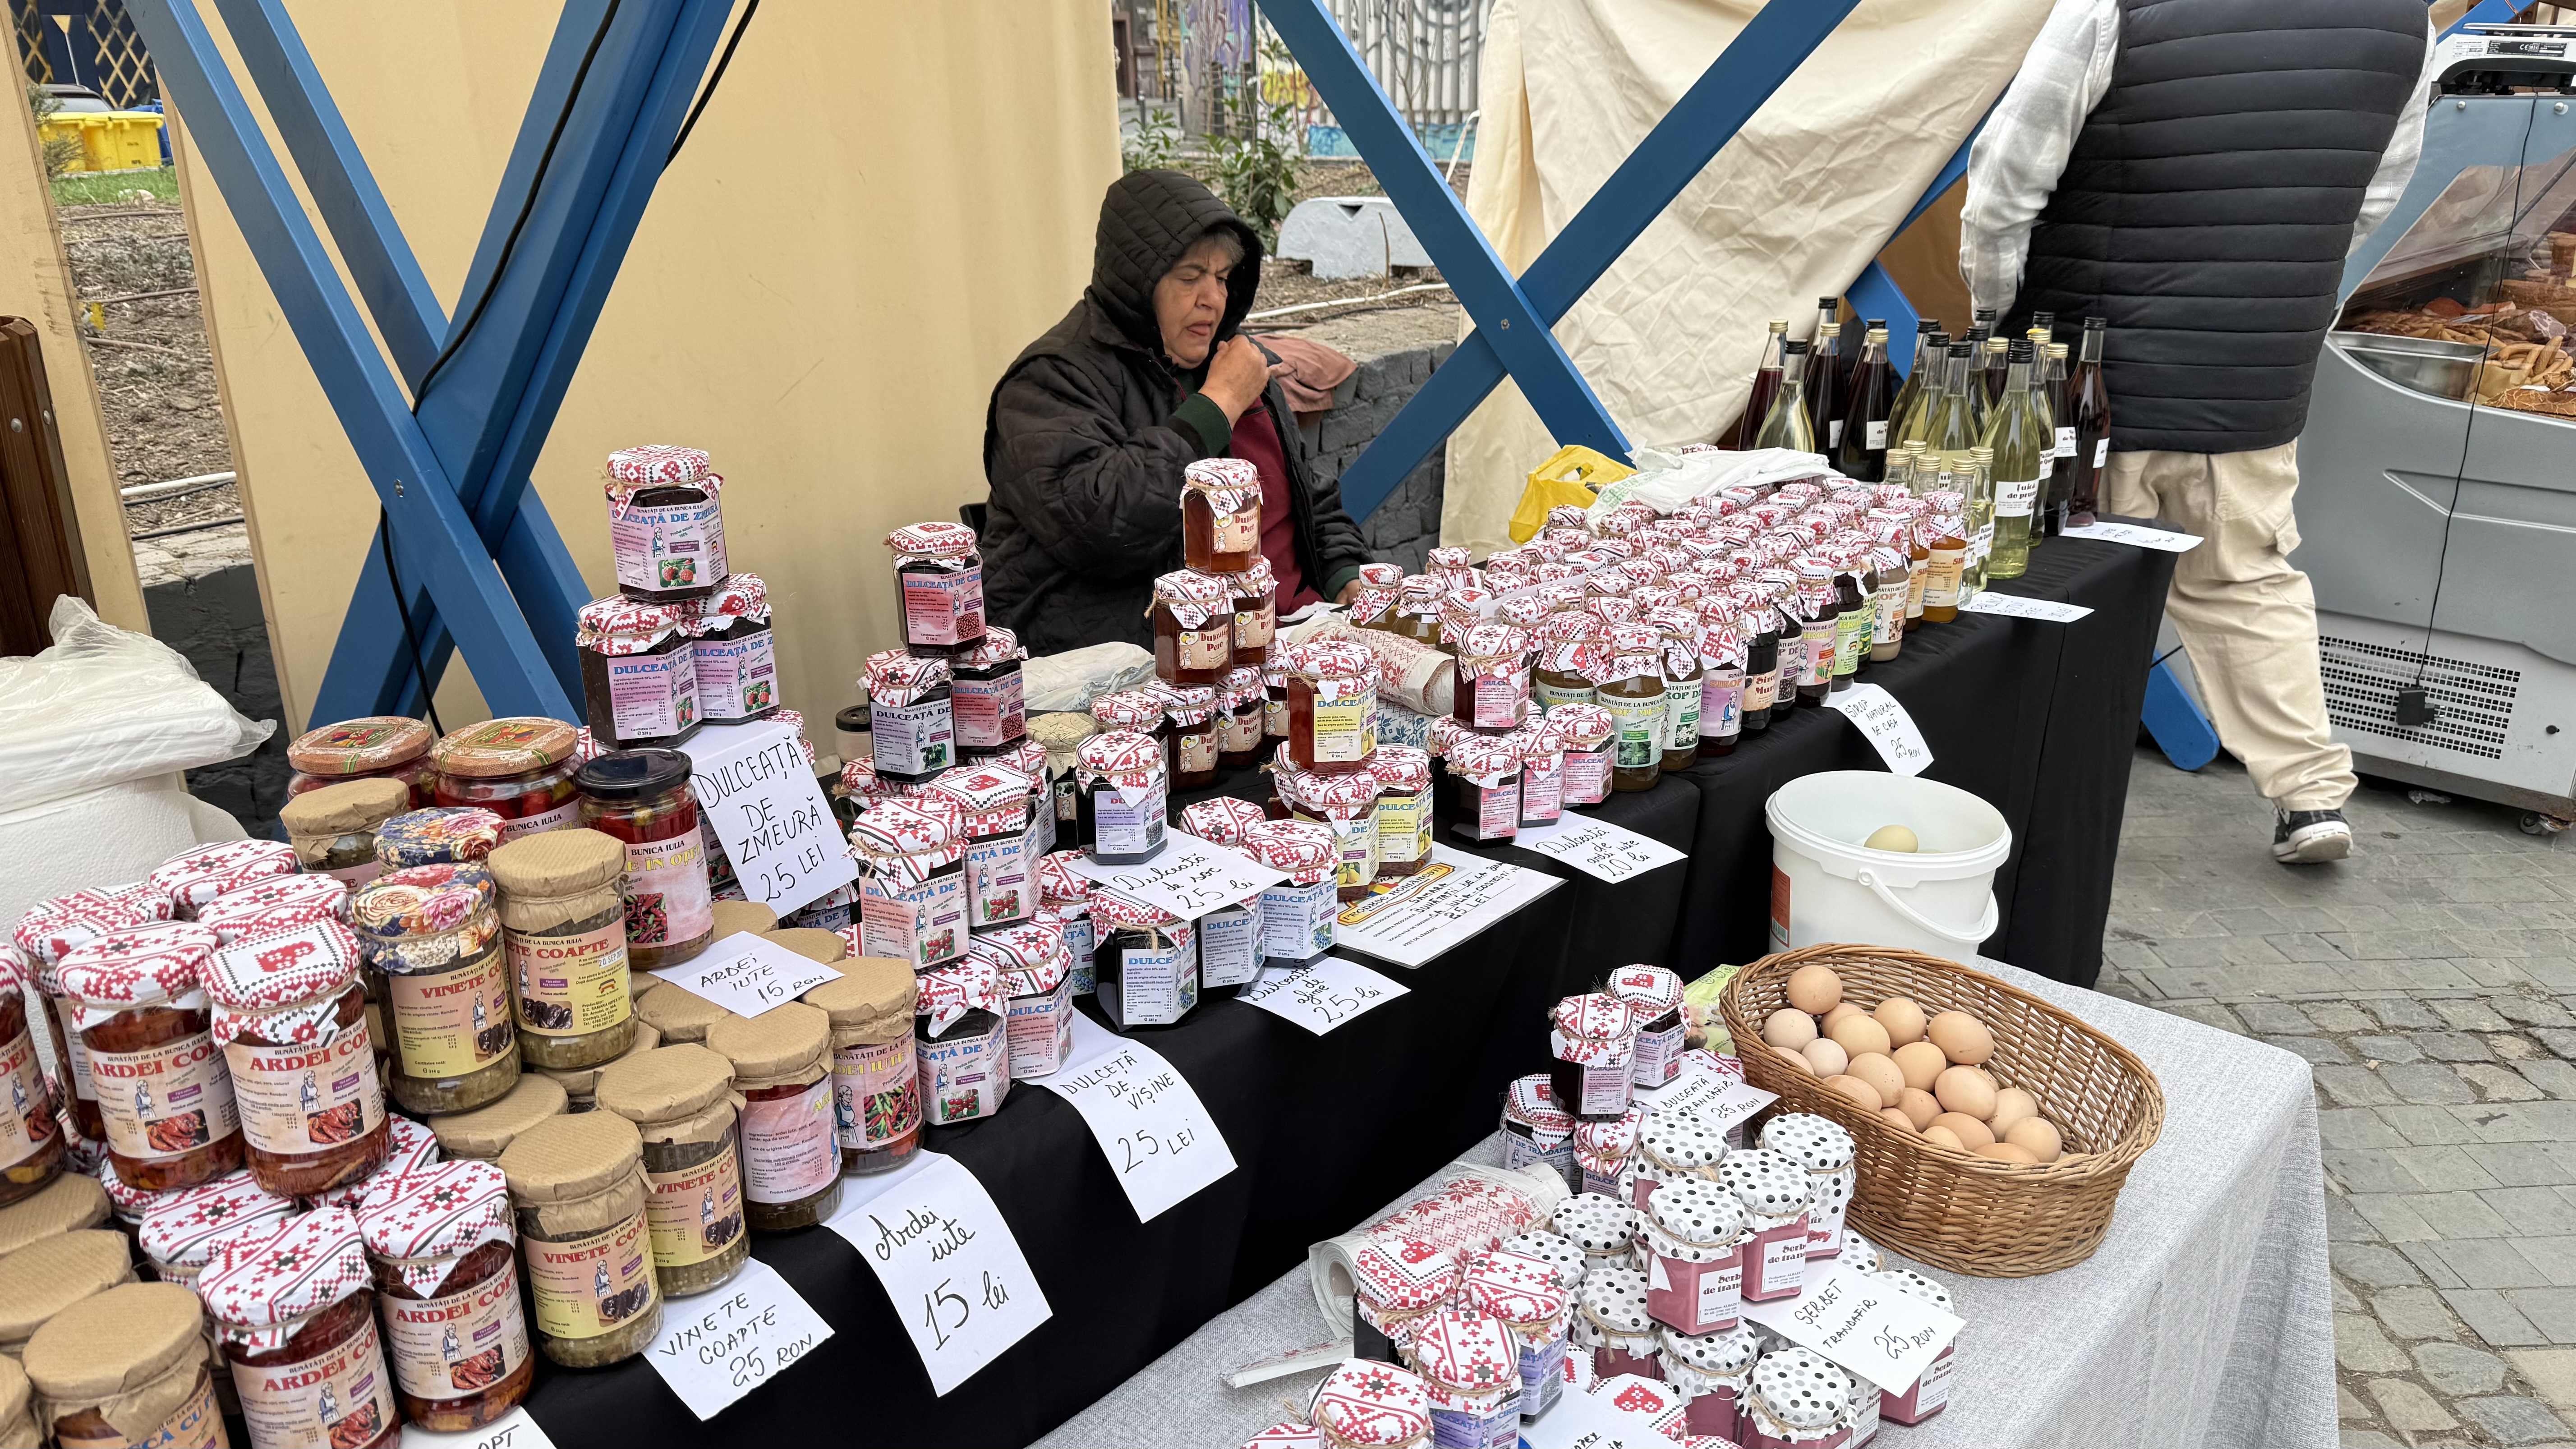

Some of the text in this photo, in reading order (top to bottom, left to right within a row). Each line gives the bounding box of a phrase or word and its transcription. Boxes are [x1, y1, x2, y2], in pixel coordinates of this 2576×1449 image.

[671, 513, 689, 522] DE
[695, 639, 764, 658] ULCEAȚĂ DE
[614, 654, 687, 674] DULCEAȚĂ DE
[1601, 696, 1623, 708] BUNĂTĂȚI
[1845, 699, 1868, 718] SIROP
[1866, 701, 1896, 721] NATURAL
[877, 708, 933, 721] DULCEAȚĂ
[1891, 737, 1907, 758] 25
[692, 736, 801, 808] DULCEAȚĂ
[506, 814, 562, 832] BUNICA IULIA
[741, 797, 776, 832] DE
[738, 796, 822, 865] ZMEURĂ
[631, 840, 685, 856] BUNICA IULIA
[1002, 845, 1021, 856] DE
[1594, 842, 1611, 852] de
[646, 856, 664, 871] ÎN
[761, 836, 825, 902] 25 LEI
[1599, 852, 1651, 876] 20 lei
[939, 882, 957, 894] DE
[1167, 867, 1221, 891] de soc
[1177, 879, 1255, 909] 25 lei
[1264, 883, 1337, 903] DULCEAȚĂ DE
[1444, 893, 1491, 919] 25 LEI
[1207, 918, 1249, 930] DULCE
[536, 938, 609, 958] COAPTE
[608, 954, 616, 963] SEP
[451, 967, 478, 981] BUNĂTĂȚI
[700, 952, 757, 988] ARDEI
[729, 964, 773, 991] IUTE
[420, 974, 485, 998] VINETE
[758, 975, 824, 1004] 15 RON
[1306, 978, 1325, 989] de
[1313, 986, 1384, 1023] 25 lei
[108, 1055, 138, 1063] BUNĂTĂȚI
[165, 1044, 189, 1055] BUNICA
[192, 1035, 207, 1046] IULIA
[250, 1048, 331, 1071] ARDEI
[275, 1045, 309, 1056] BUNĂTĂȚI
[877, 1048, 887, 1056] DE
[963, 1044, 983, 1054] DE
[93, 1060, 165, 1078] ARDEI
[870, 1052, 906, 1073] IUTE
[1105, 1081, 1129, 1098] DE
[1128, 1073, 1174, 1109] VIȘINE
[1711, 1098, 1761, 1119] 25 RON
[1118, 1118, 1195, 1173] 25 LEI
[656, 1170, 715, 1194] VINETE
[682, 1165, 708, 1178] BUNĂTĂȚI
[1586, 1173, 1619, 1186] DULCEA
[869, 1205, 940, 1260] Ardei
[927, 1219, 975, 1262] iute
[543, 1244, 610, 1263] VINETE
[570, 1238, 600, 1250] BUNĂTĂȚI
[417, 1300, 449, 1308] BUNĂTĂȚI
[473, 1282, 492, 1296] BUNICA
[494, 1271, 505, 1283] IULIA
[396, 1302, 471, 1323] ARDEI
[926, 1271, 1008, 1351] 15 lei
[1822, 1299, 1877, 1348] TRANDAFIR
[699, 1305, 775, 1364] COAPTE
[1874, 1325, 1936, 1359] 25 RON
[290, 1358, 324, 1373] BUNĂTĂȚI
[730, 1334, 811, 1386] 25 RON
[263, 1356, 347, 1391] ARDEI
